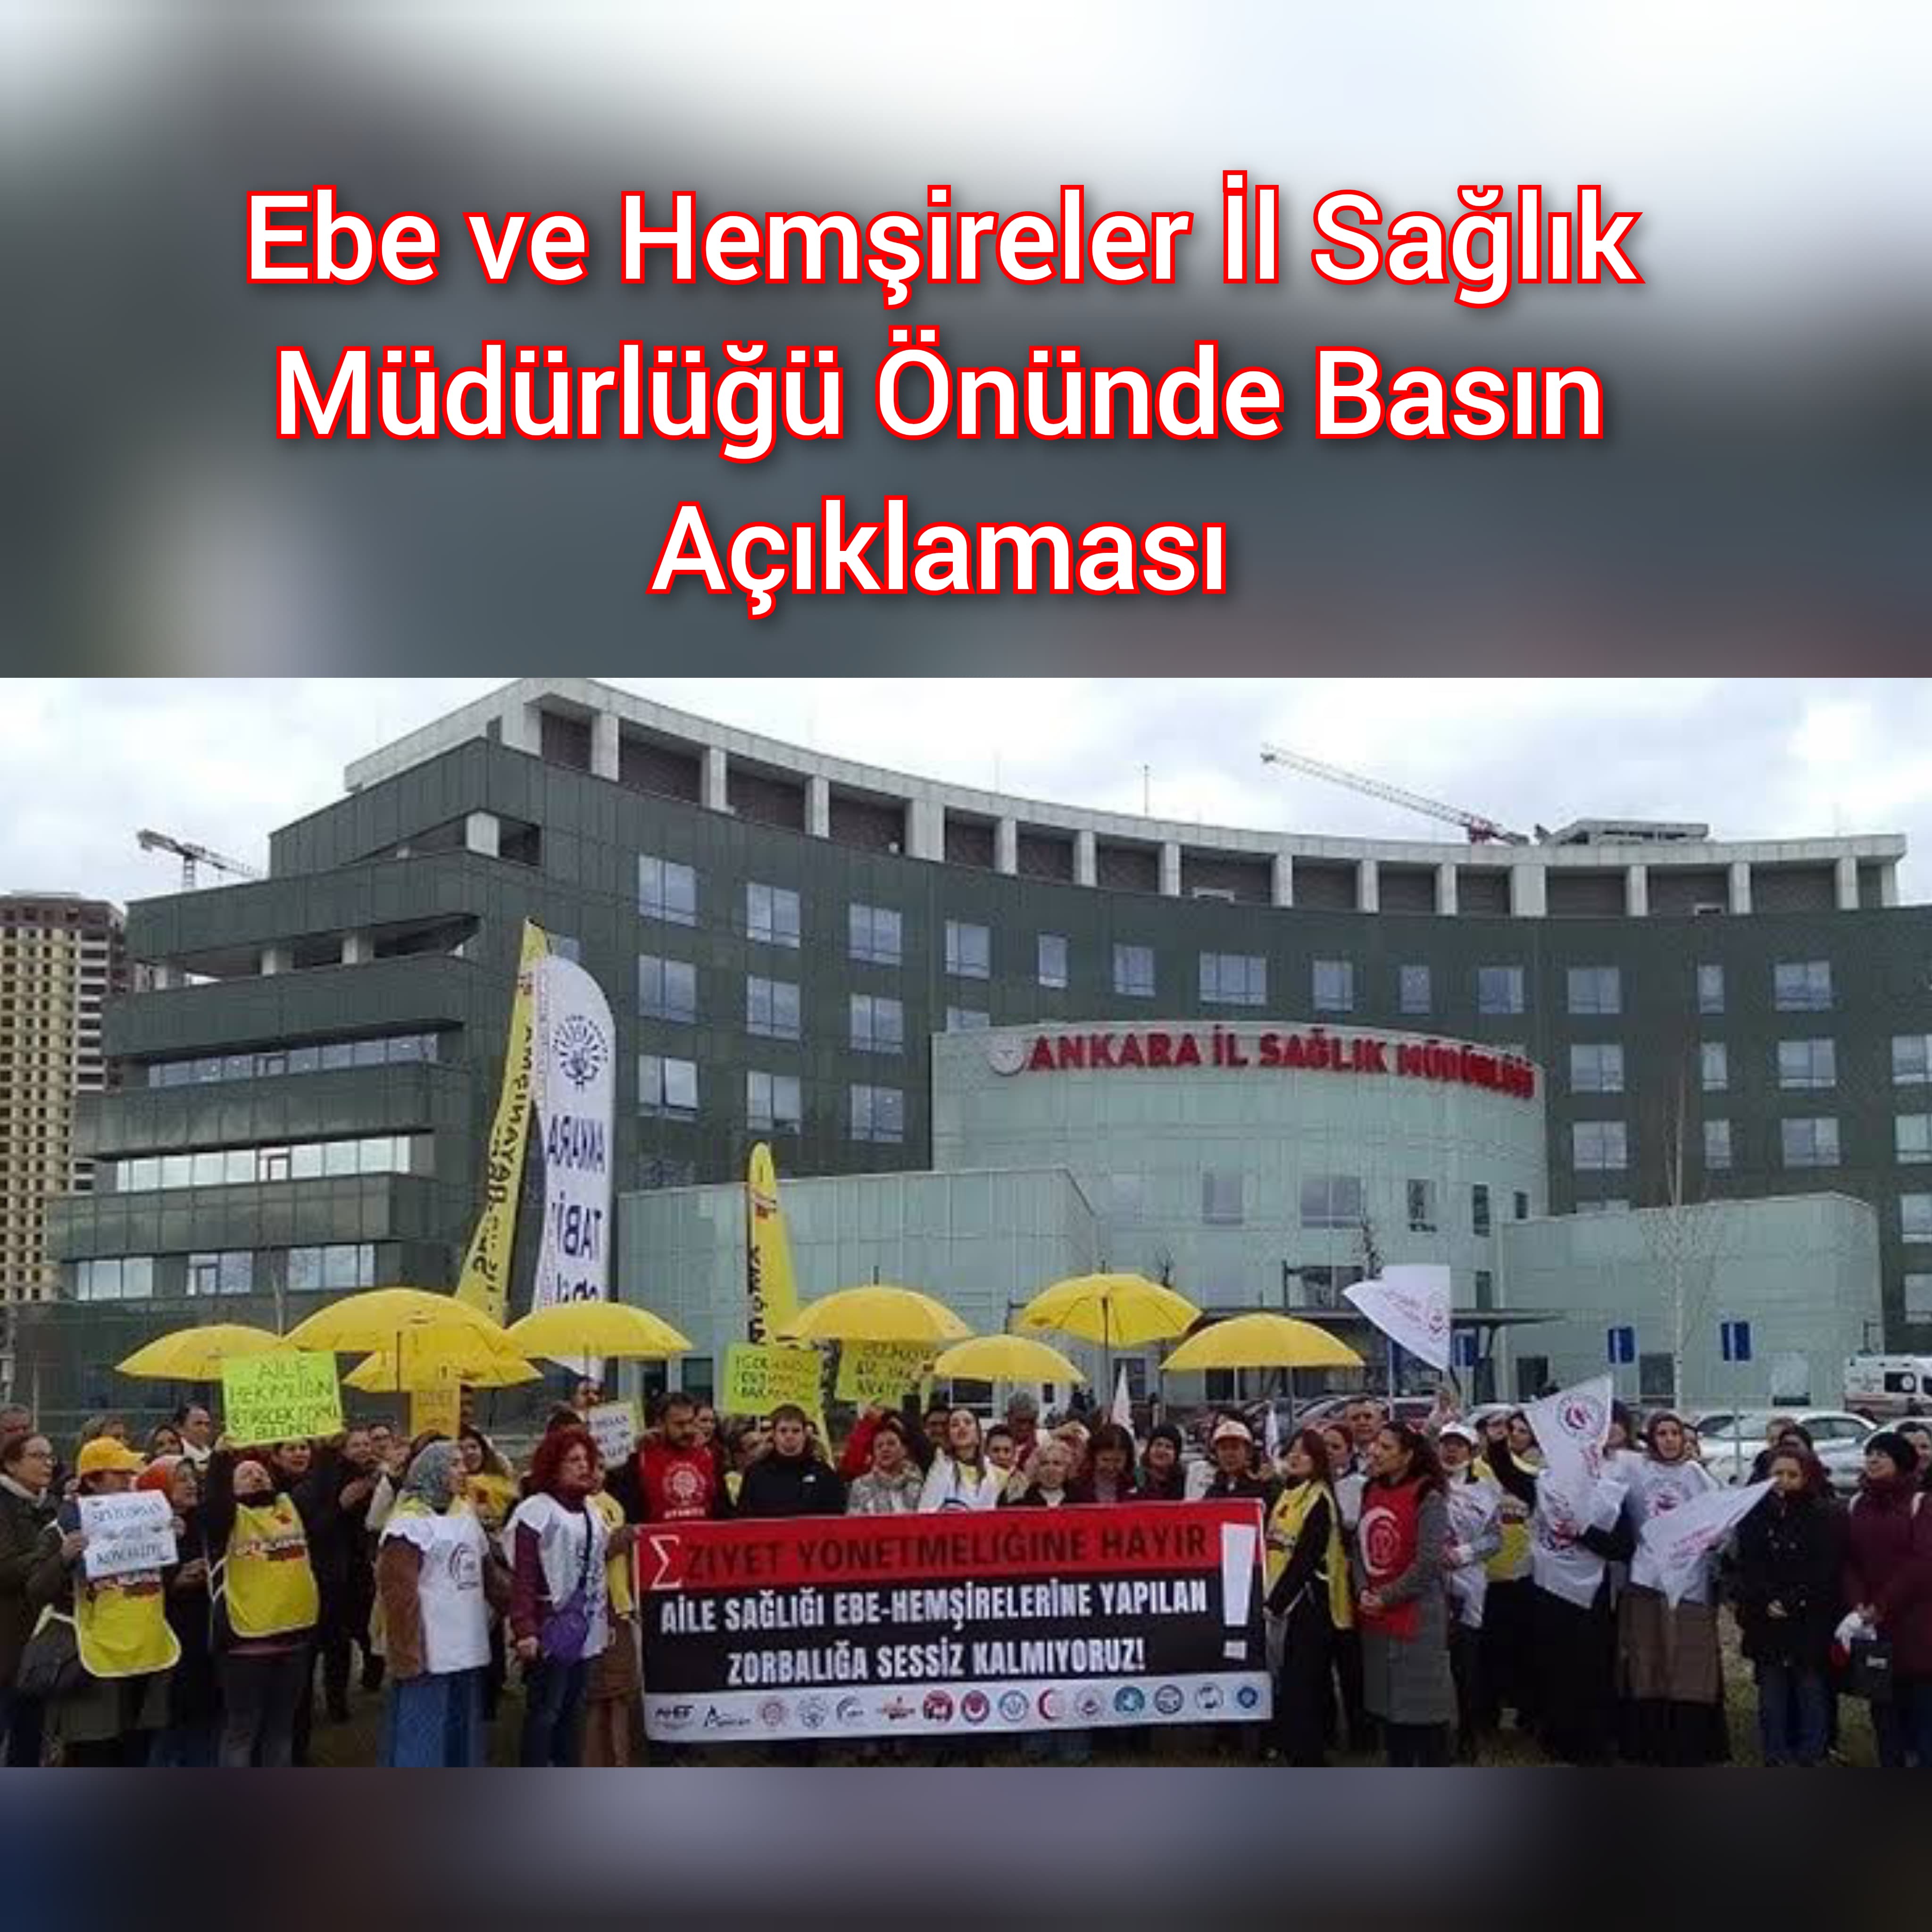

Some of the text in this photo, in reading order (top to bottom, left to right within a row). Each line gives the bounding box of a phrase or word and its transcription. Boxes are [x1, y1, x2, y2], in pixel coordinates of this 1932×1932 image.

[1028, 1033, 1201, 1070] ANKARA
[1213, 1024, 1248, 1067] İL
[1259, 1028, 1387, 1072] SAĞLIK
[1102, 1524, 1207, 1562] HAYIR
[661, 1577, 1207, 1635] AİLE SAĞLIĞI EBE-HEMŞİRELERİNE YAPILAN
[727, 1636, 1146, 1687] ZORBALIĞA SESSİZ KALMIYORUZ!
